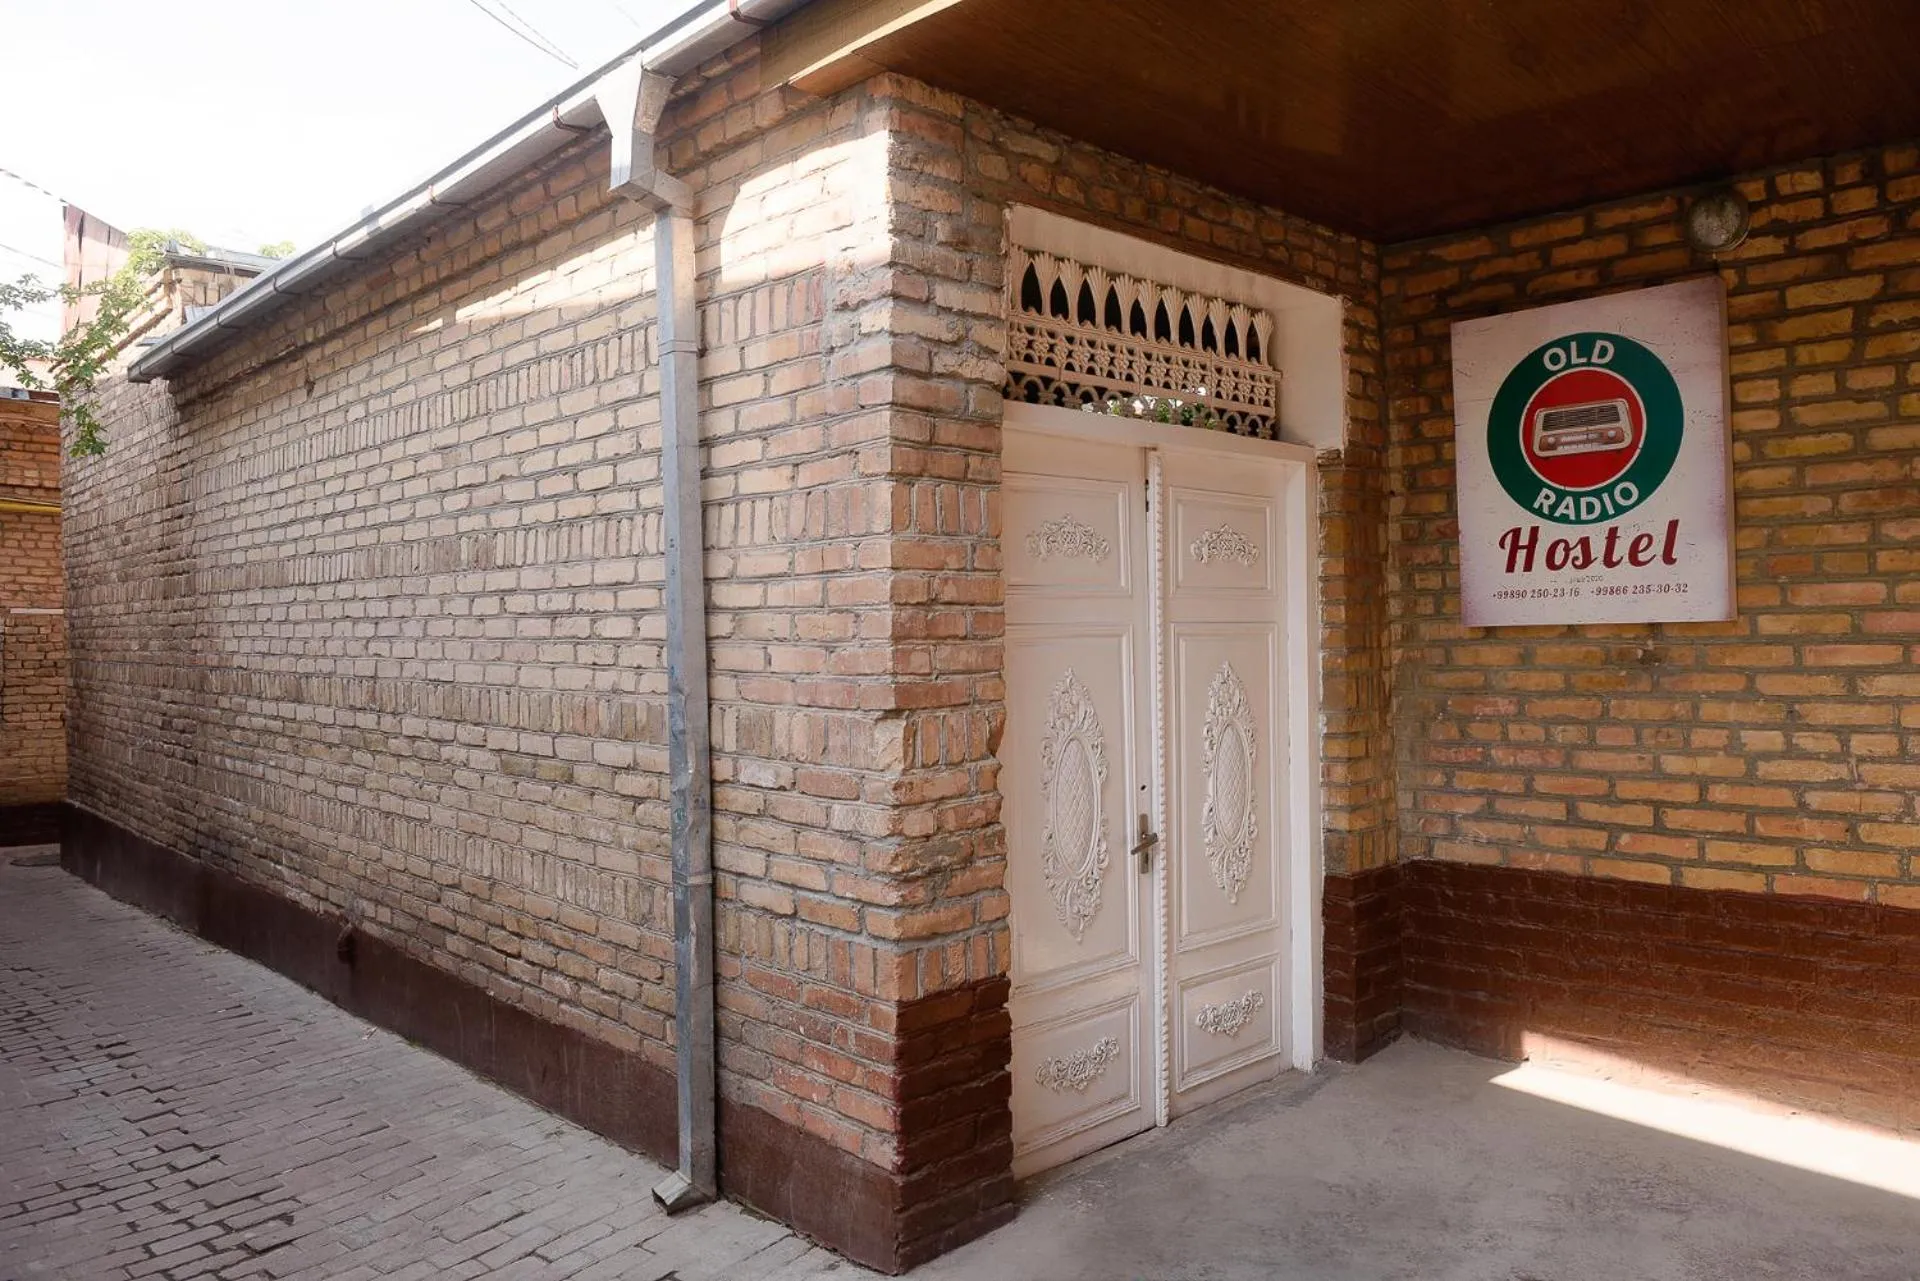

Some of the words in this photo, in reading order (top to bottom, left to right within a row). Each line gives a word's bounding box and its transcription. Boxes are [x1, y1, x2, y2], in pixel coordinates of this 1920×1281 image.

[1543, 339, 1615, 371] OLD
[1533, 481, 1639, 520] RADIO
[1499, 519, 1679, 573] Hostel
[1631, 583, 1689, 595] 235-30-32
